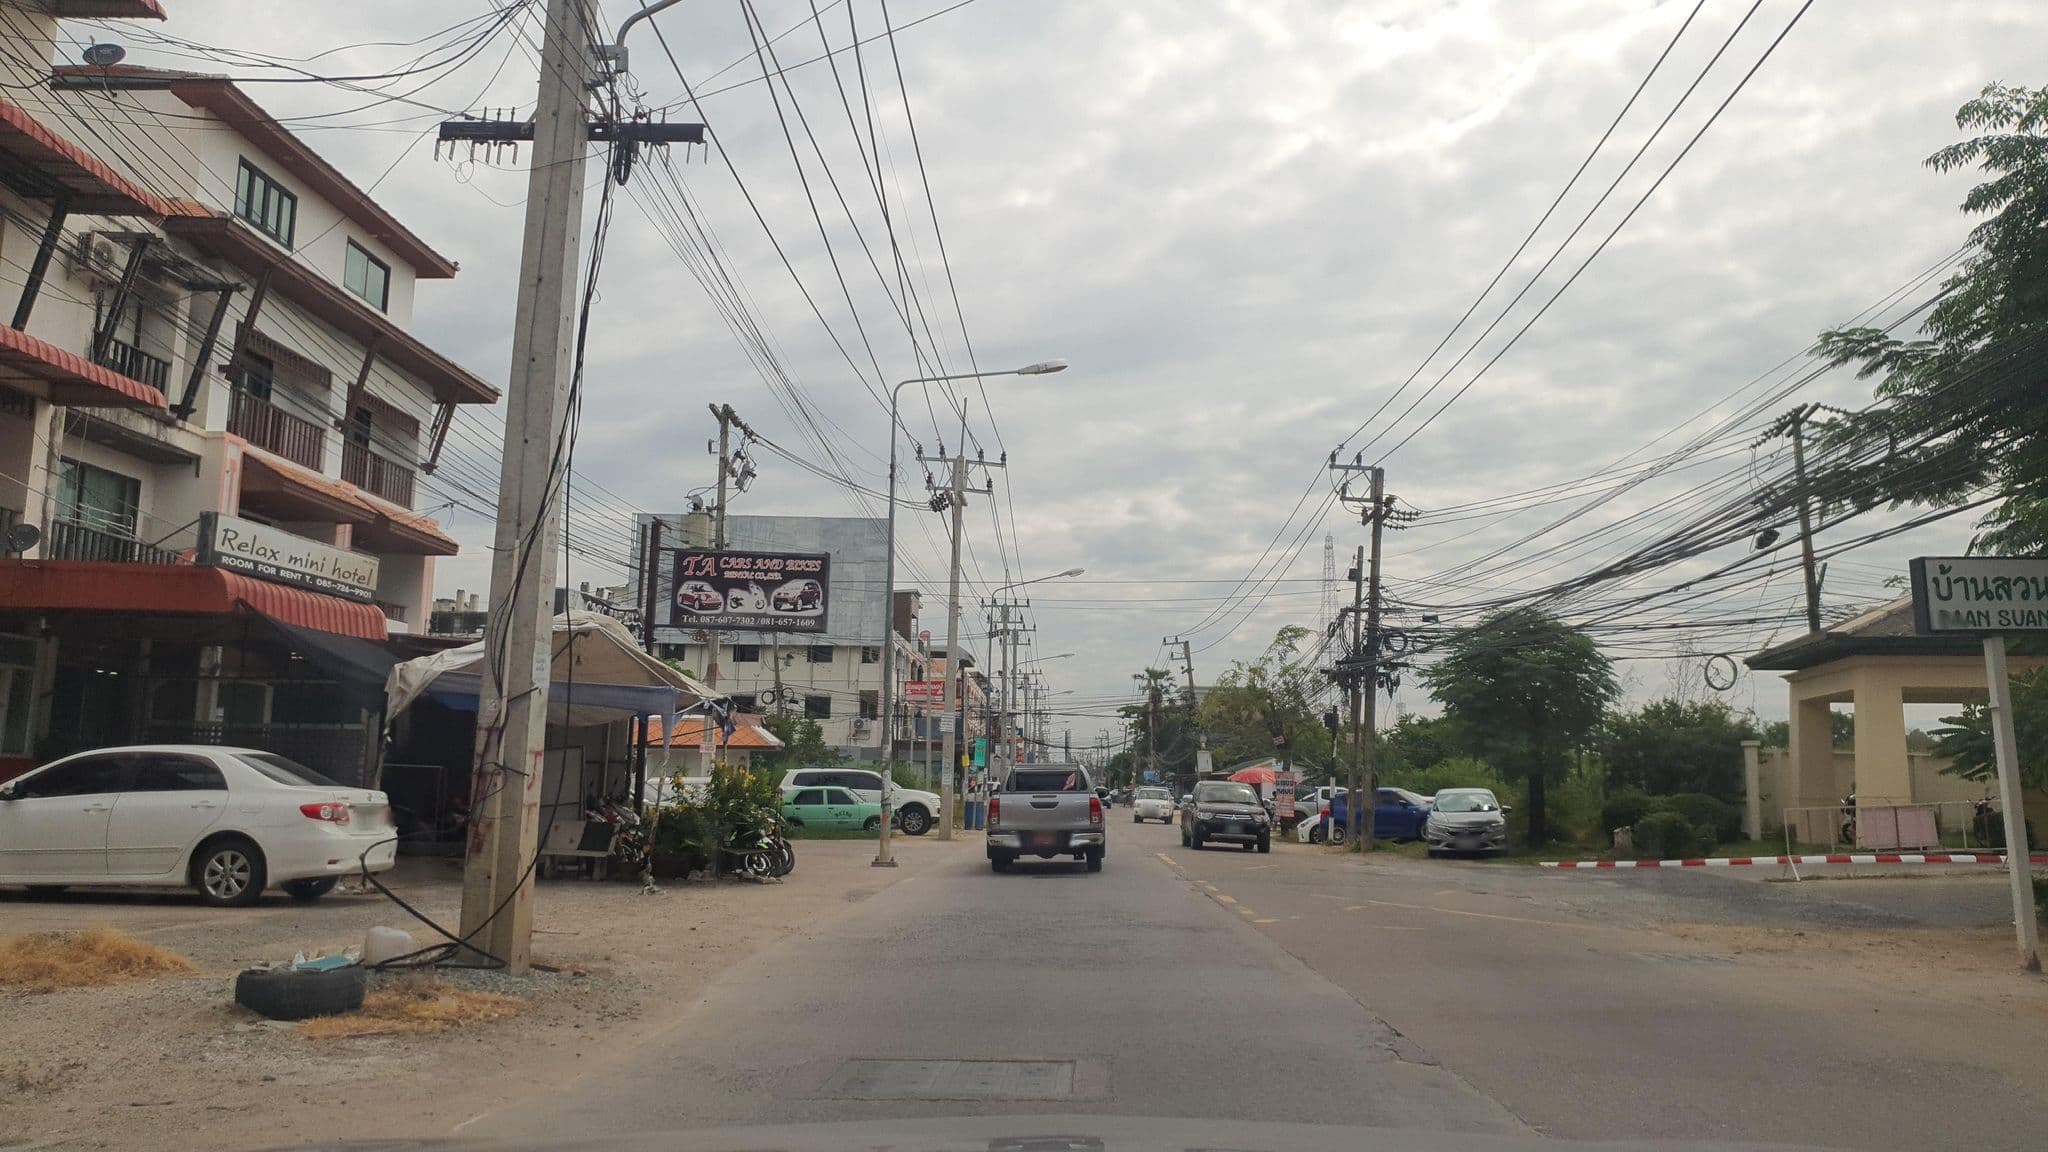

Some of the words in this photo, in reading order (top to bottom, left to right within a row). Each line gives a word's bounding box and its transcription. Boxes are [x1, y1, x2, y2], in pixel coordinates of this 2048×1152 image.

[221, 527, 281, 561] Relax
[288, 551, 326, 573] mini
[332, 557, 374, 586] hotel
[720, 557, 752, 569] CARS
[753, 558, 784, 570] AND
[785, 560, 822, 572] BIKES
[221, 555, 254, 570] ROOM
[258, 564, 277, 575] FOR
[280, 569, 303, 580] RENT
[682, 614, 698, 623] Tel.
